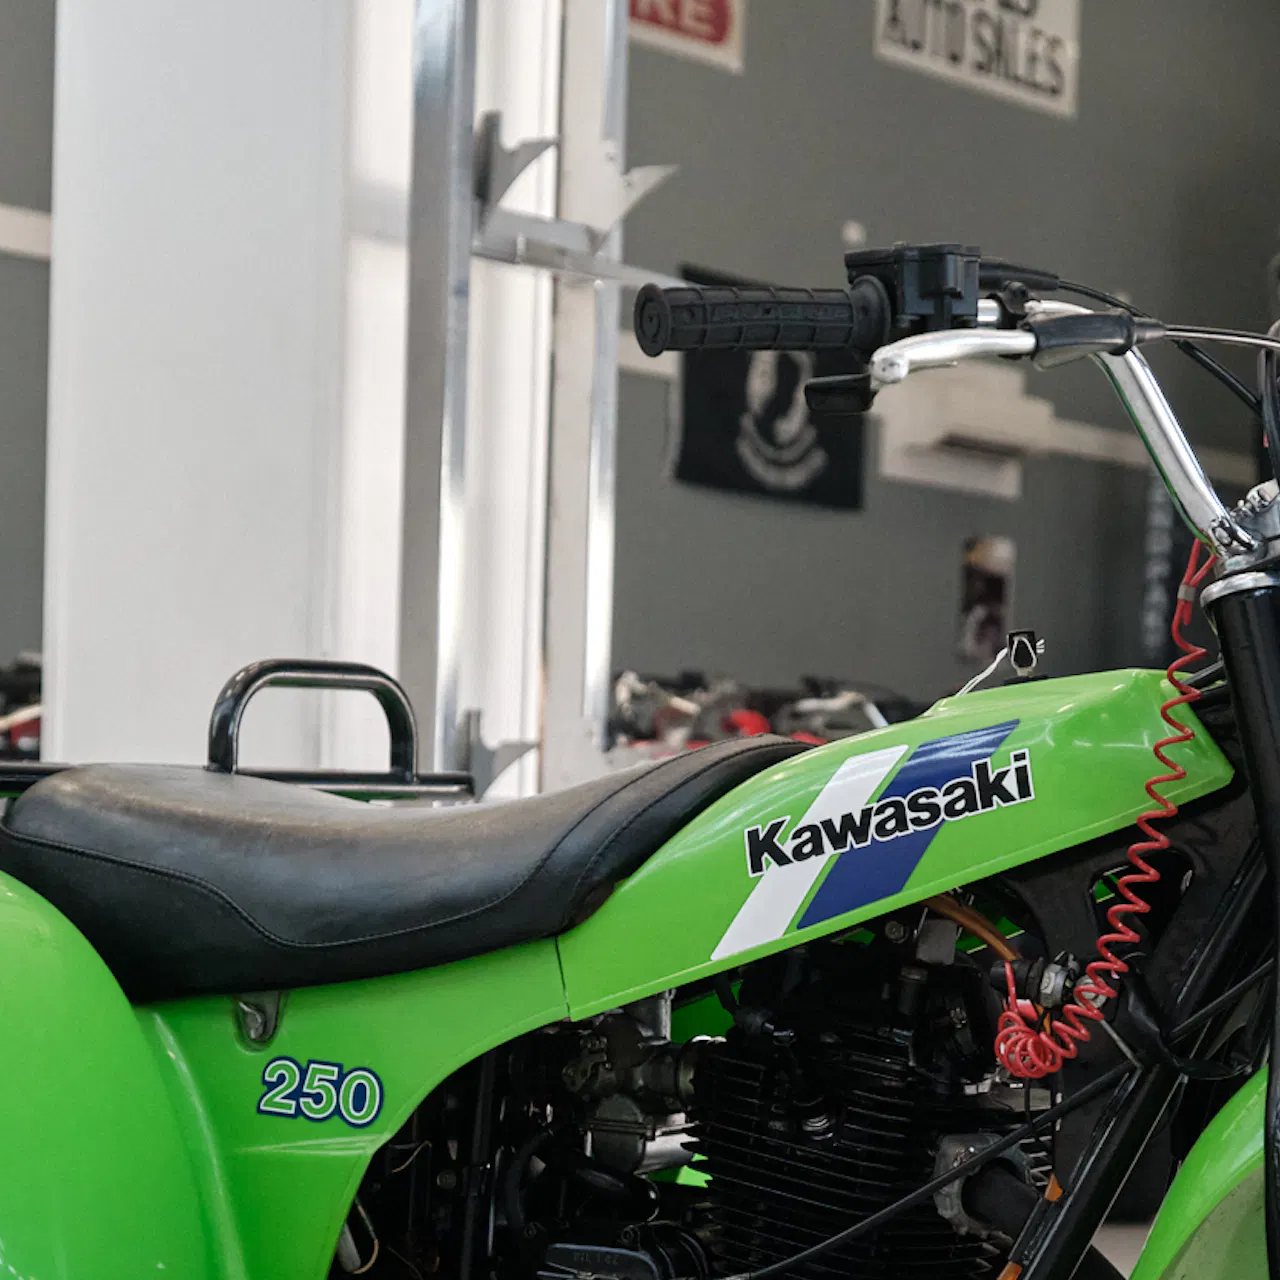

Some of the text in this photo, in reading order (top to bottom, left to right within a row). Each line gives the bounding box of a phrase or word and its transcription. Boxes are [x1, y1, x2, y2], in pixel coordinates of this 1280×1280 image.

[972, 9, 1065, 97] SALES
[745, 749, 1034, 876] Kawasaki
[257, 1056, 384, 1129] 250
